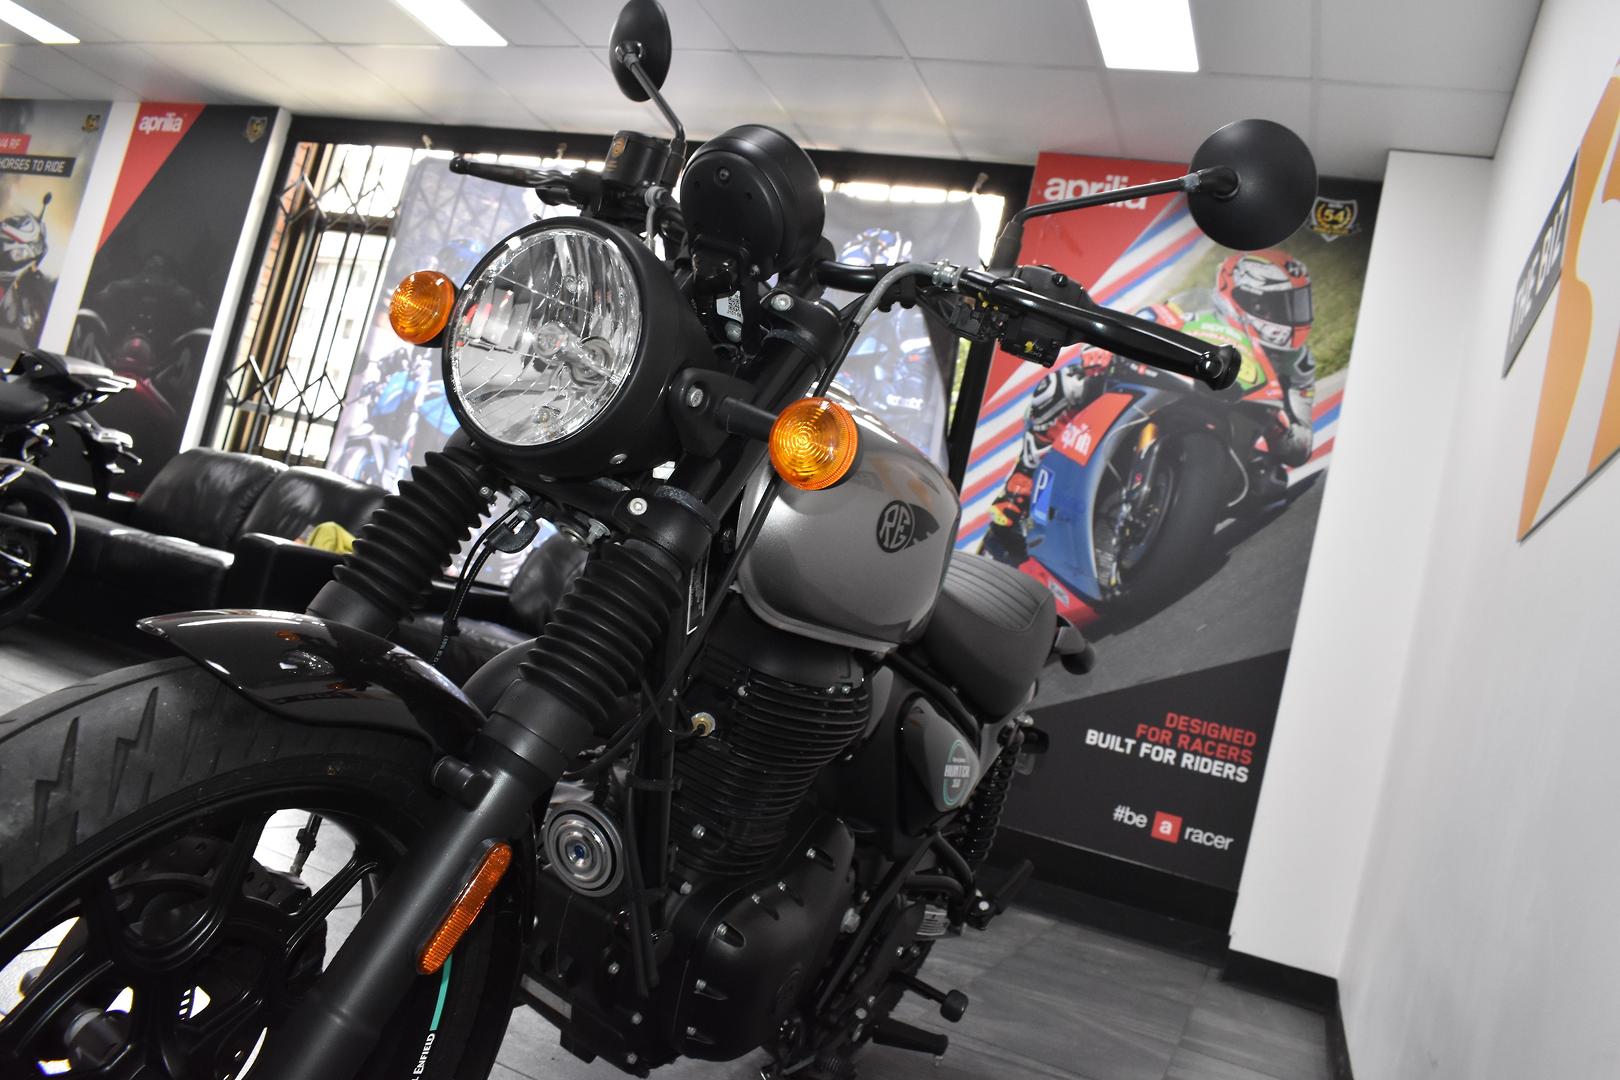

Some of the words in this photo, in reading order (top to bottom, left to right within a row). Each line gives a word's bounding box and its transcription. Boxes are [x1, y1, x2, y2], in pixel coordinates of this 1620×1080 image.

[139, 112, 183, 134] aprilia
[32, 159, 45, 172] TO
[44, 160, 66, 173] RIDE
[1323, 208, 1345, 222] 54
[1135, 723, 1173, 746] FOR
[1177, 735, 1253, 766] RACERS
[1164, 712, 1257, 748] DESIGNED
[1085, 728, 1136, 755] BUILT
[1139, 741, 1175, 766] FOR
[1180, 752, 1249, 783] RIDERS
[1112, 804, 1148, 829] #be
[1184, 825, 1234, 851] racer
[413, 1033, 435, 1074] ENFIELD
